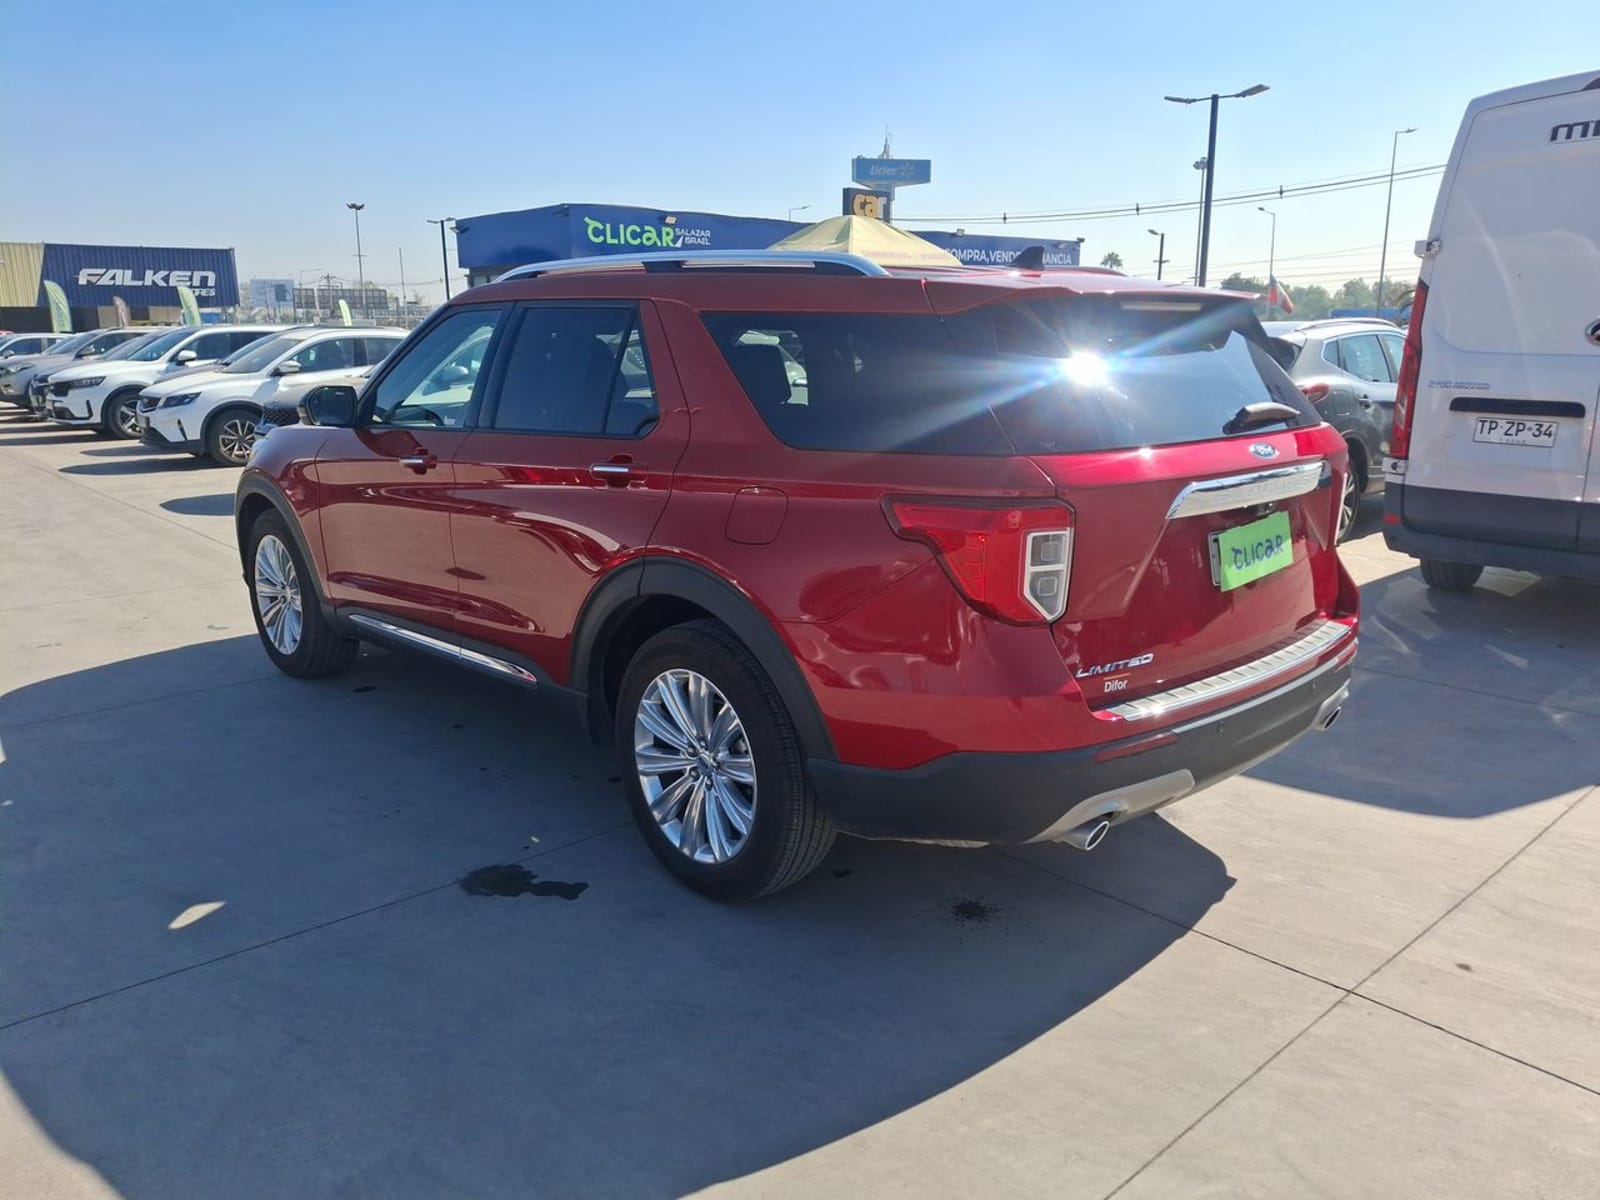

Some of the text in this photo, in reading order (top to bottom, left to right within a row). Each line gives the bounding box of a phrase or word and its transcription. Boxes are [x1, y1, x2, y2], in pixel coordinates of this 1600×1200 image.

[676, 228, 711, 238] SALAZAR
[685, 237, 711, 246] ISRAEL
[77, 268, 216, 287] FALKEN
[191, 288, 216, 297] IRES
[1075, 653, 1154, 678] LIMITED
[1104, 680, 1129, 693] Difor
